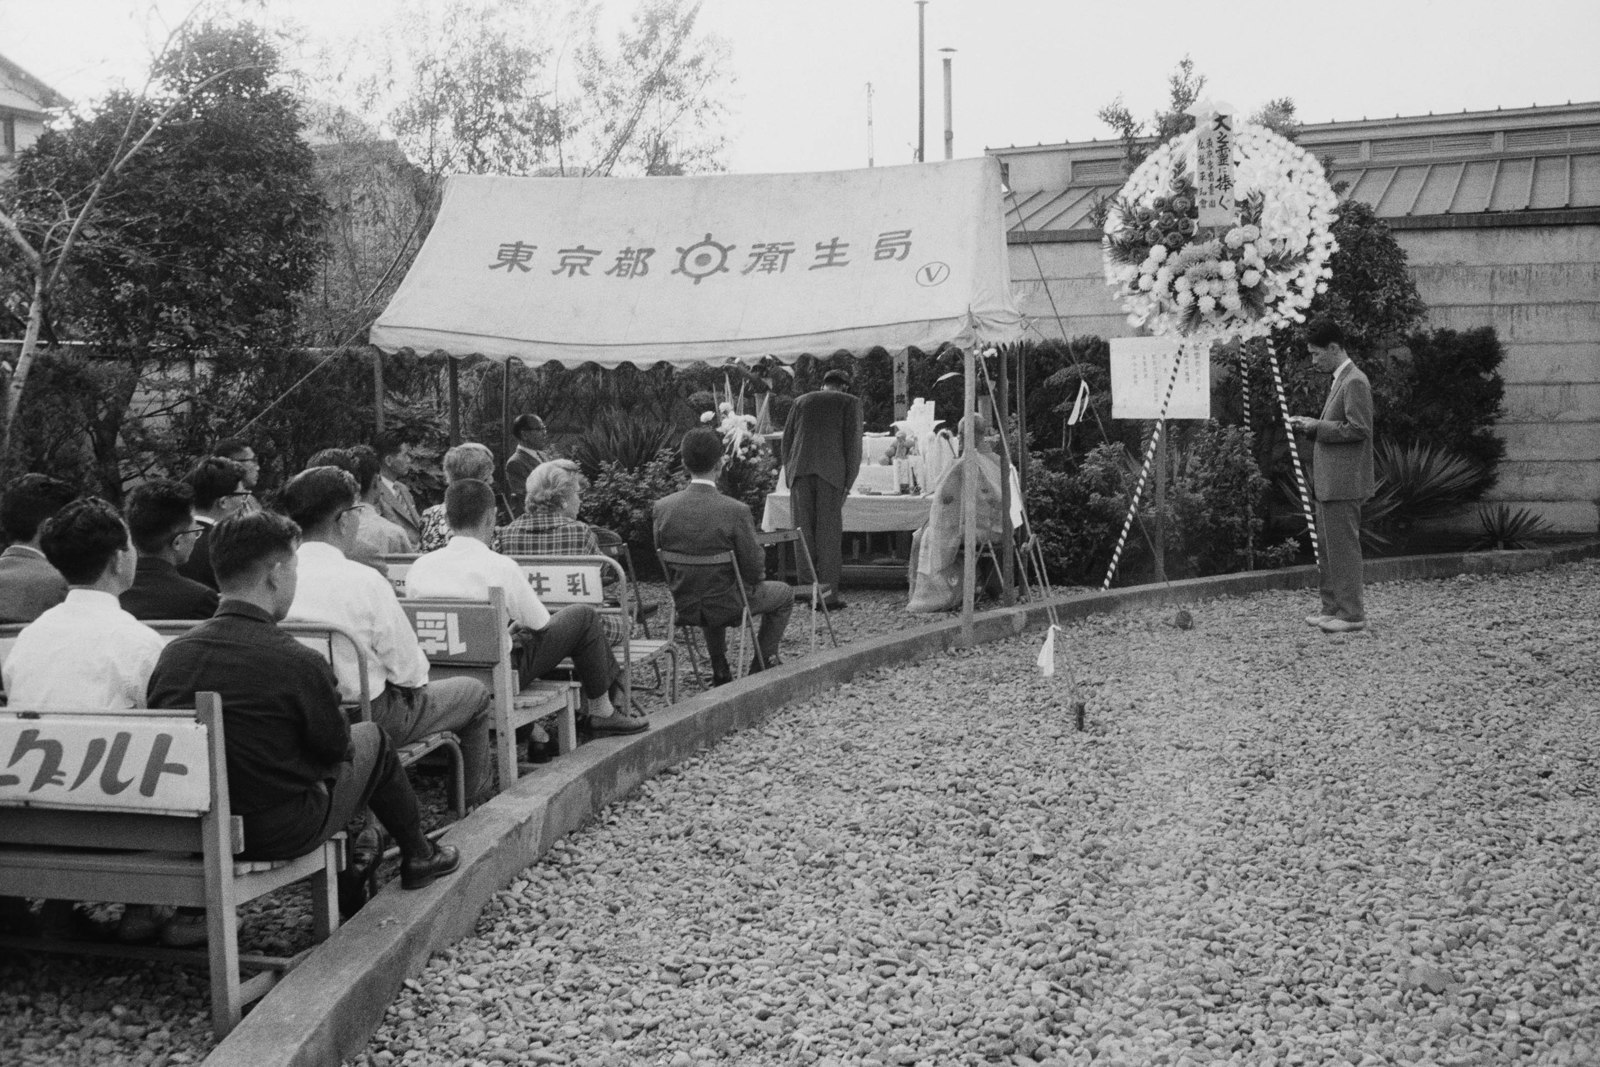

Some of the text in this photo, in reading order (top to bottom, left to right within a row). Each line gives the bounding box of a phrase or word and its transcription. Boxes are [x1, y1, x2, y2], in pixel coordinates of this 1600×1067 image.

[488, 229, 913, 280] 東京都 衛生局
[528, 571, 591, 597] 牛乳
[0, 728, 189, 798] クルト
